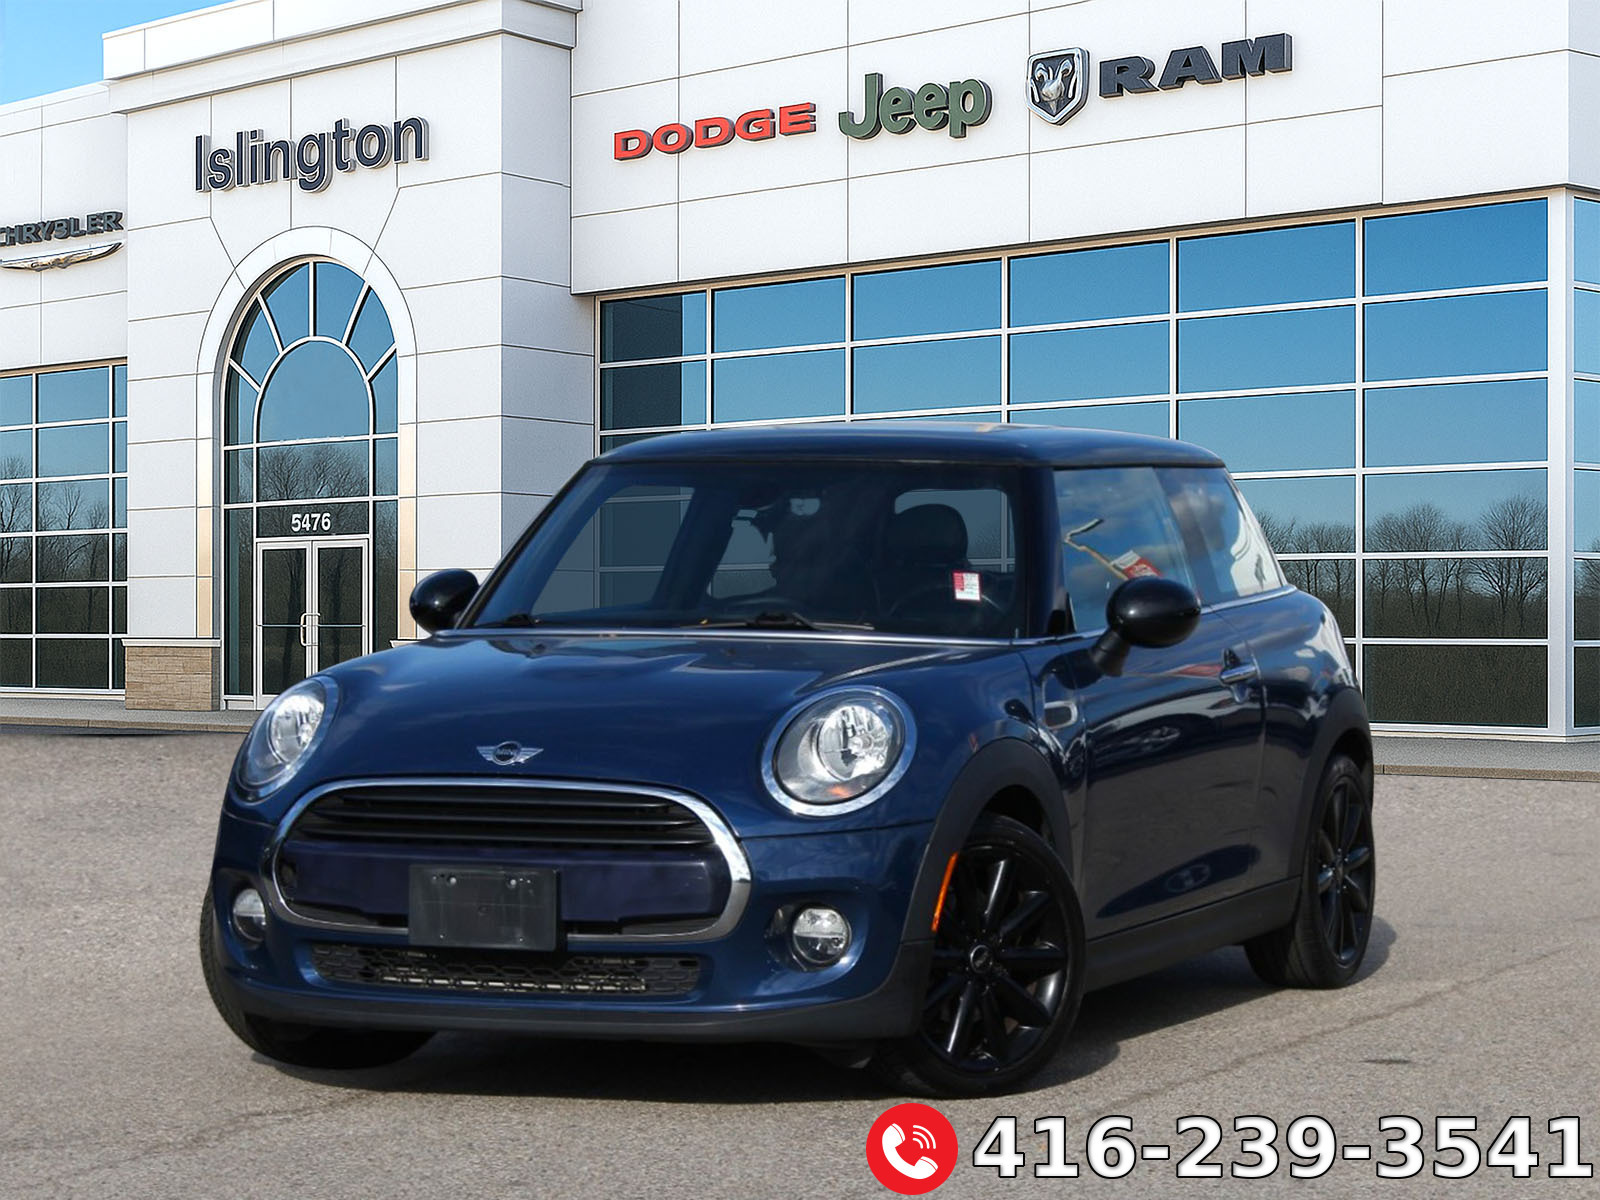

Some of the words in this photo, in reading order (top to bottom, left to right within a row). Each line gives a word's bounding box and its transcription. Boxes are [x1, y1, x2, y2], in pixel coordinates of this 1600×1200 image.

[1100, 33, 1293, 98] RAM
[613, 102, 817, 161] DODGE
[839, 73, 992, 139] Jeep
[195, 115, 430, 193] Islington
[291, 512, 331, 532] 5476
